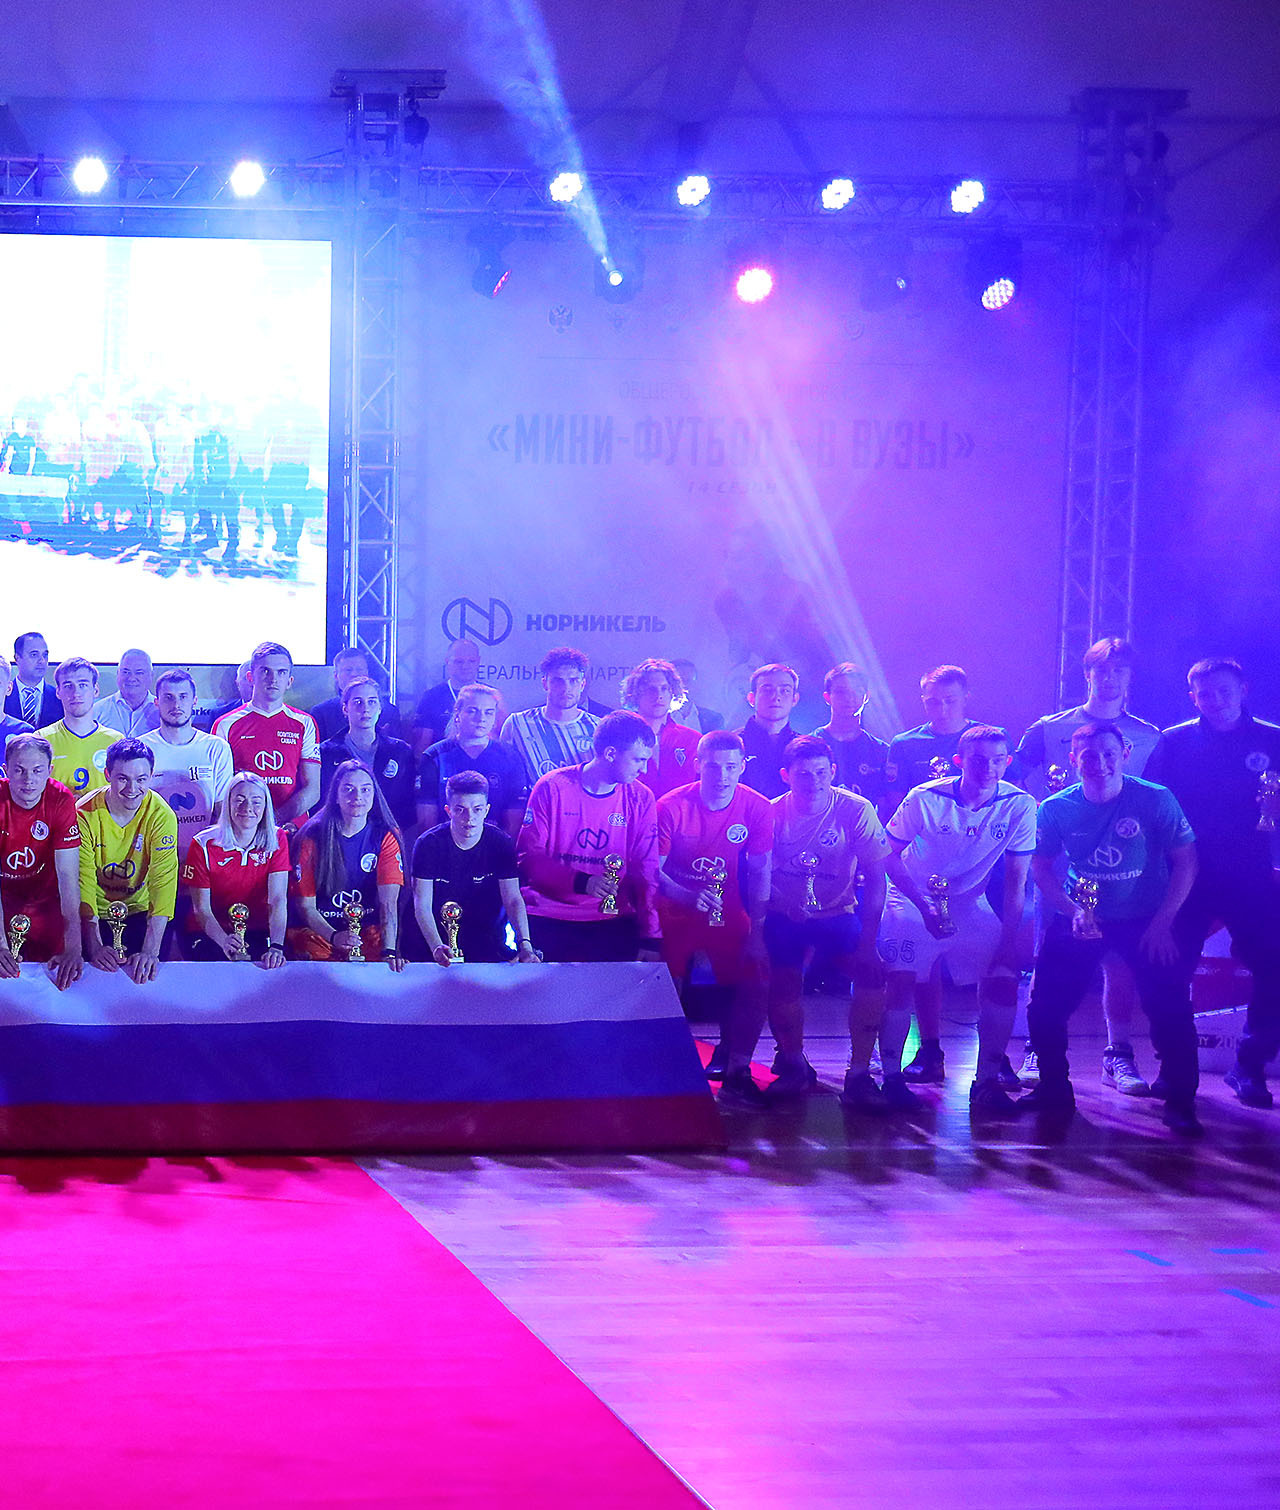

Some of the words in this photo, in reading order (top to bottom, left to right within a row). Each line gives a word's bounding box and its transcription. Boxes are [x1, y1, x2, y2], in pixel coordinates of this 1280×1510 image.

[526, 614, 666, 632] НОРНИКЕЛЬ
[74, 767, 90, 791] 9
[183, 865, 195, 880] 15
[883, 939, 915, 964] 55
